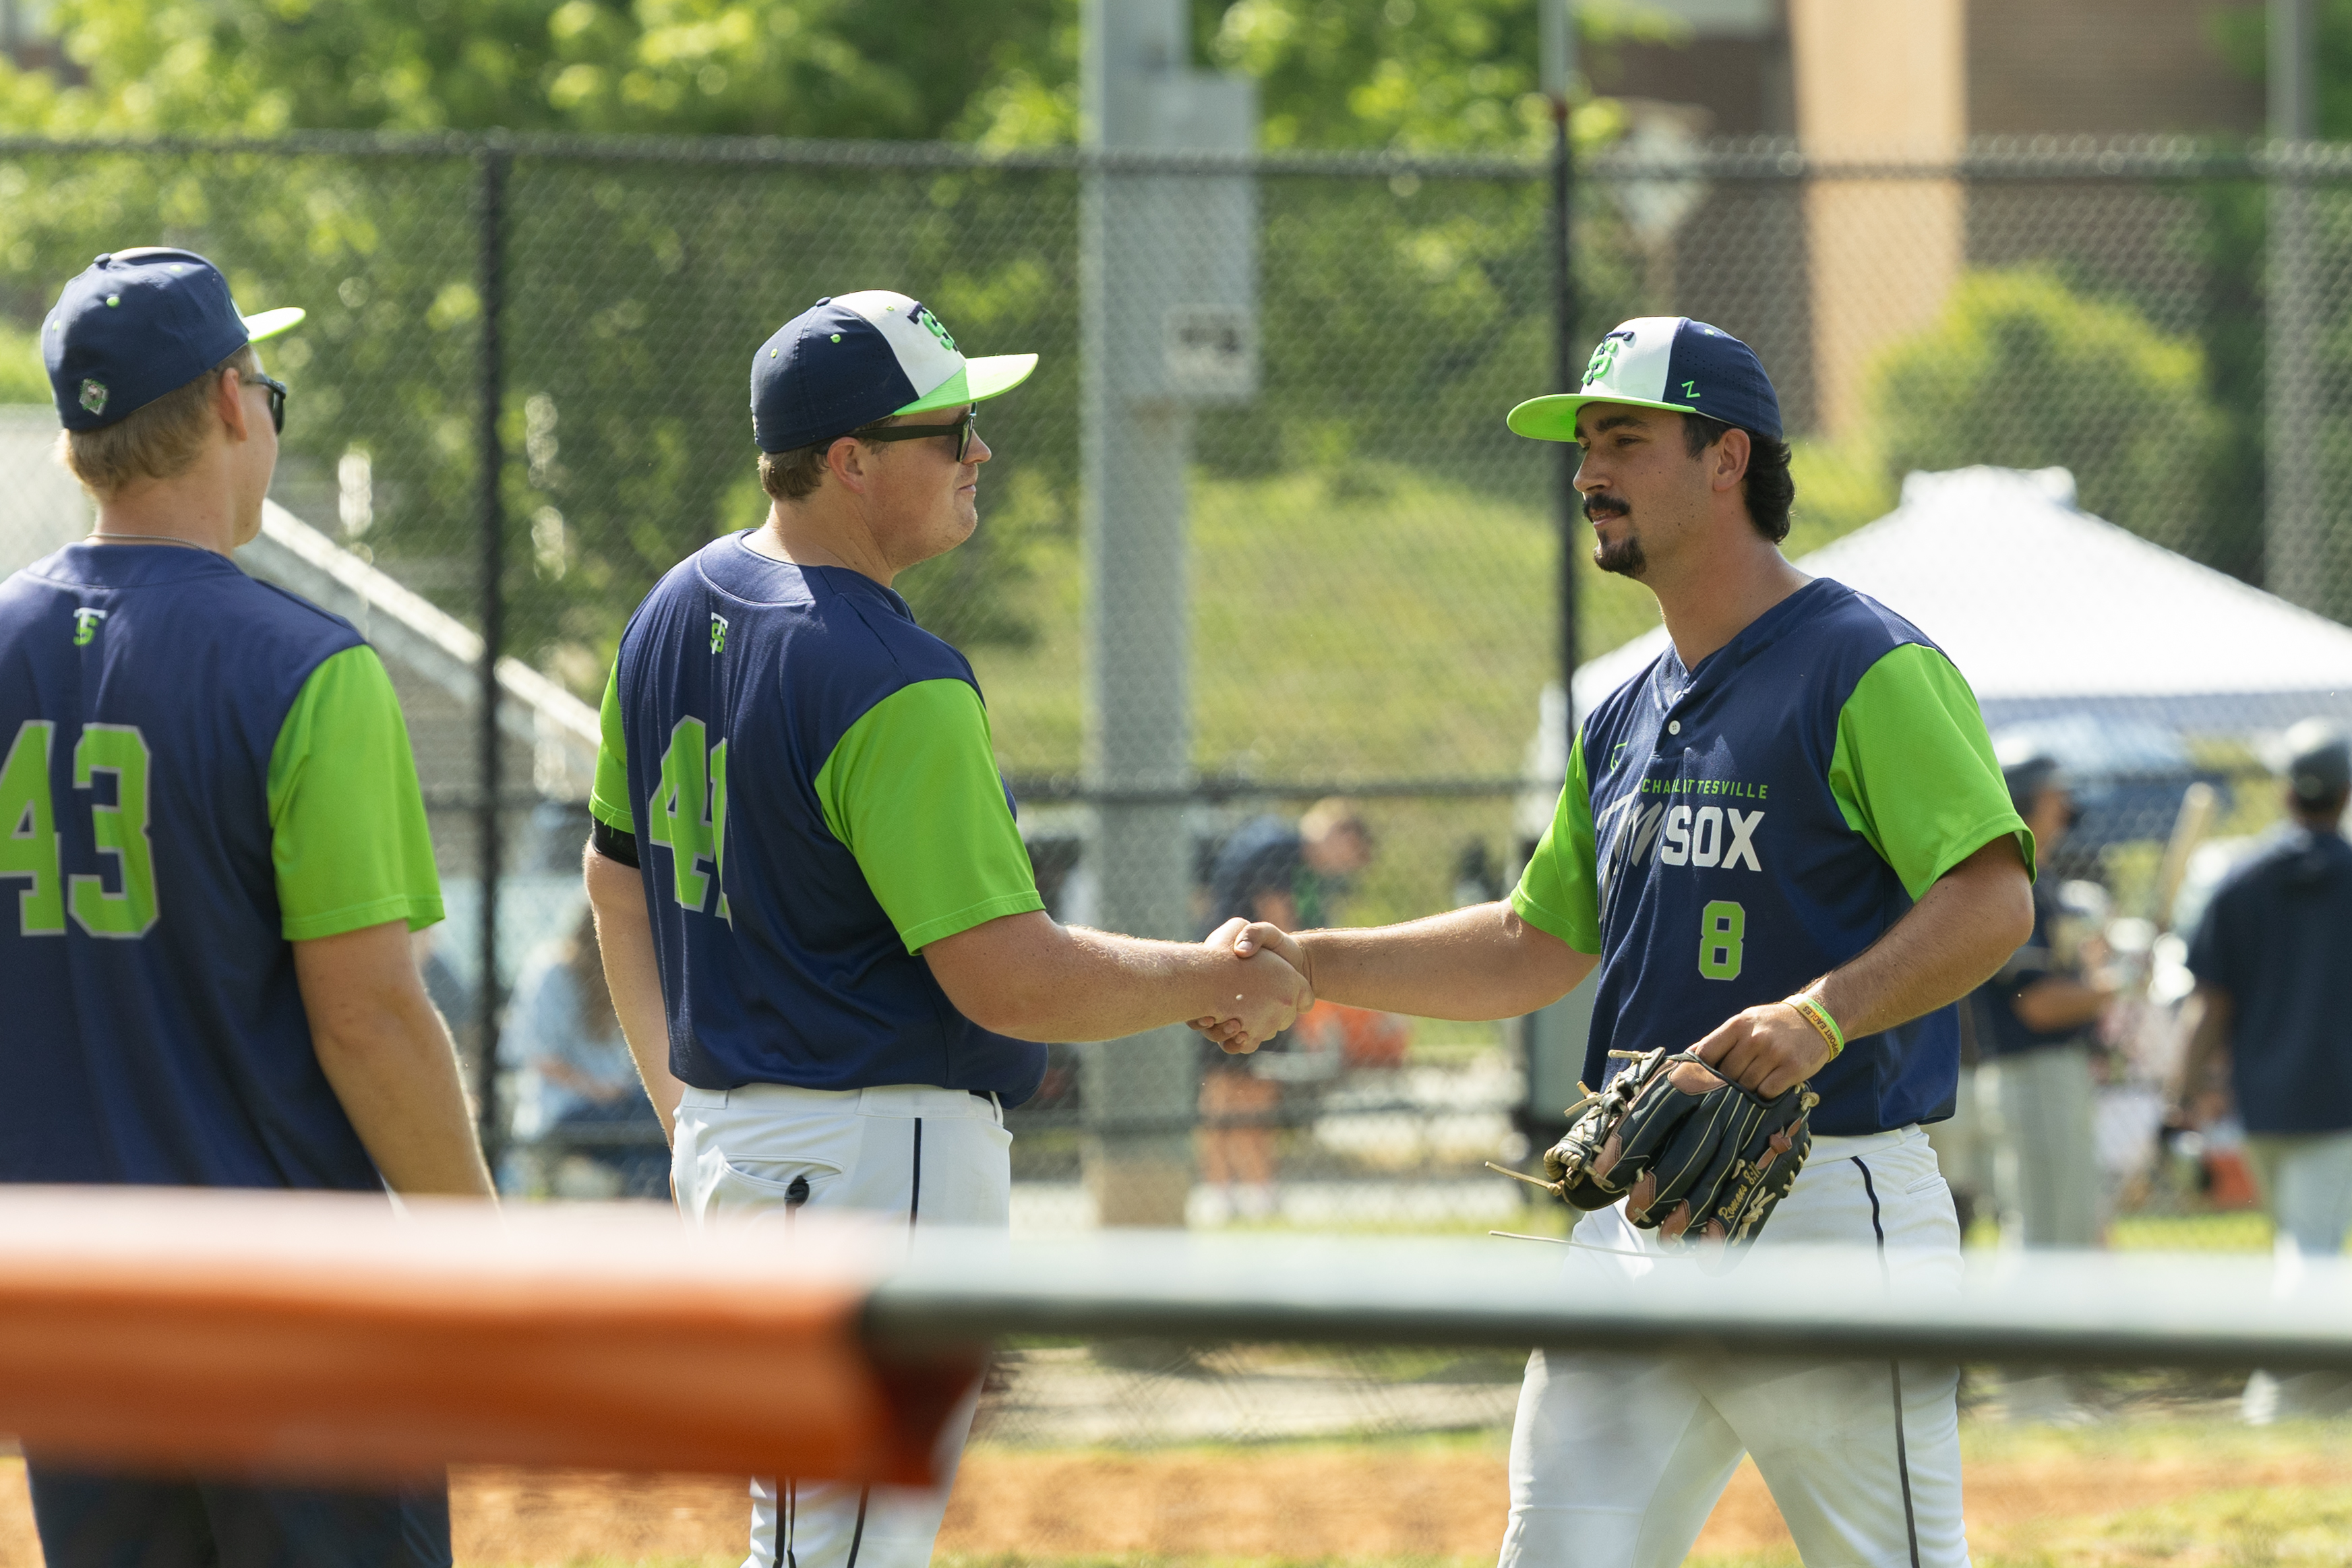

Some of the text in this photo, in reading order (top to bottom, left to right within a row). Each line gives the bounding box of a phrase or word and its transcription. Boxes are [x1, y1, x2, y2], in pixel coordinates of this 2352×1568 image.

[1681, 381, 1700, 398] Z
[0, 719, 160, 939] 43
[1661, 804, 1766, 872] SOX
[1698, 900, 1745, 981] 8
[1803, 1006, 1827, 1029] EAGLES
[1823, 1029, 1840, 1055] UPPORT
[1718, 1184, 1748, 1224] Romans
